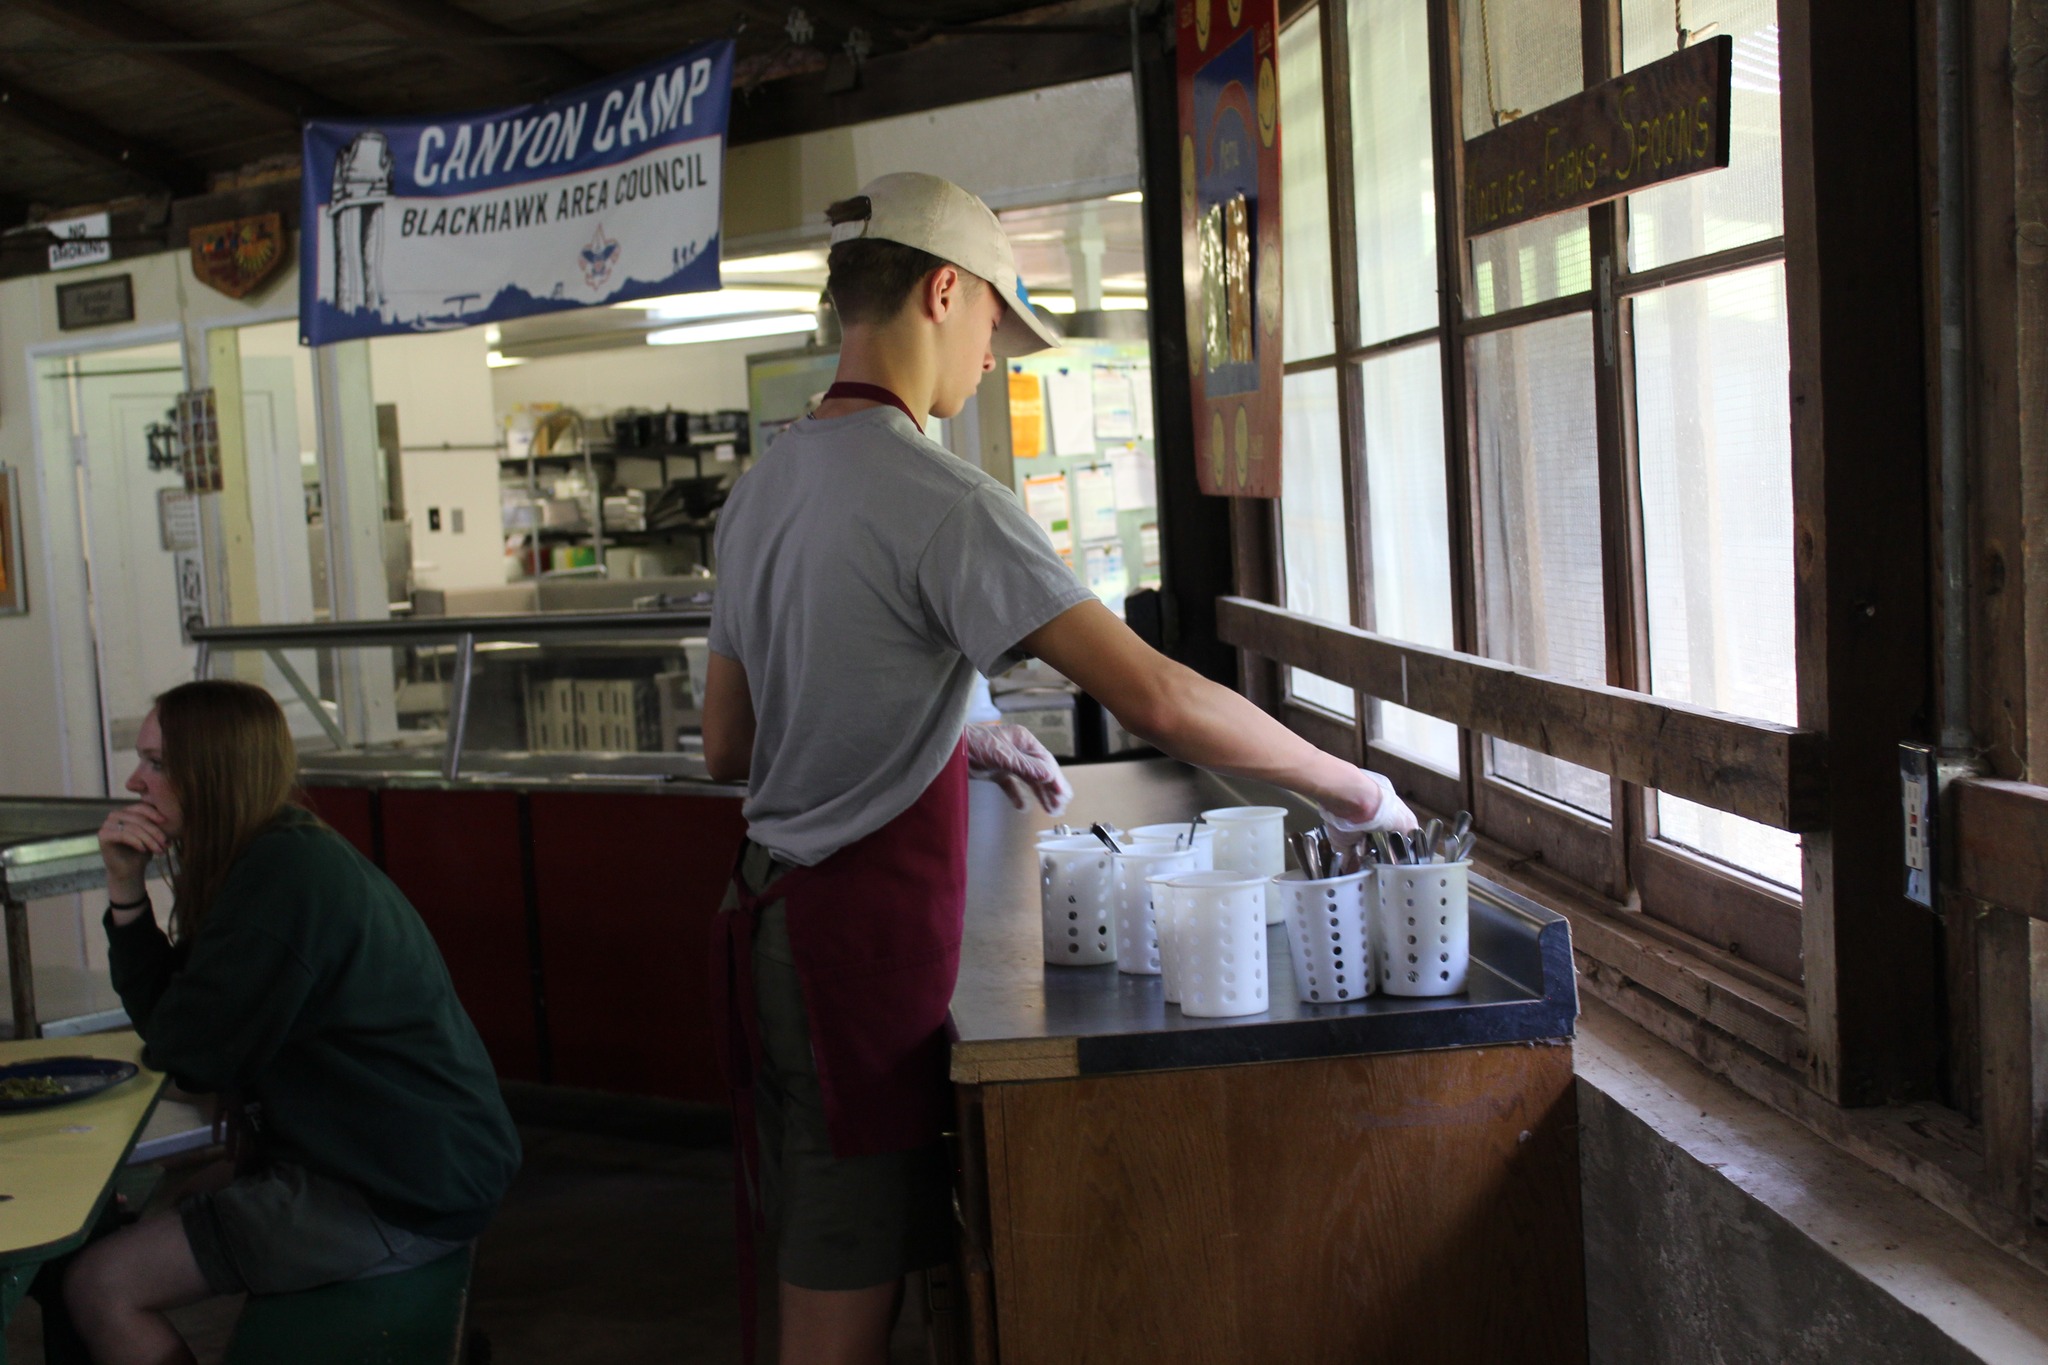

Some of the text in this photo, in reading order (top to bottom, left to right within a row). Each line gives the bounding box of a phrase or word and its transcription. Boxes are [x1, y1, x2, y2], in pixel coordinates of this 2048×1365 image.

[414, 57, 712, 187] CANYON CAMP
[1615, 84, 1710, 181] SPOONS
[68, 222, 87, 239] NO
[401, 154, 707, 237] BLACKHAWK AREA COUNCIL
